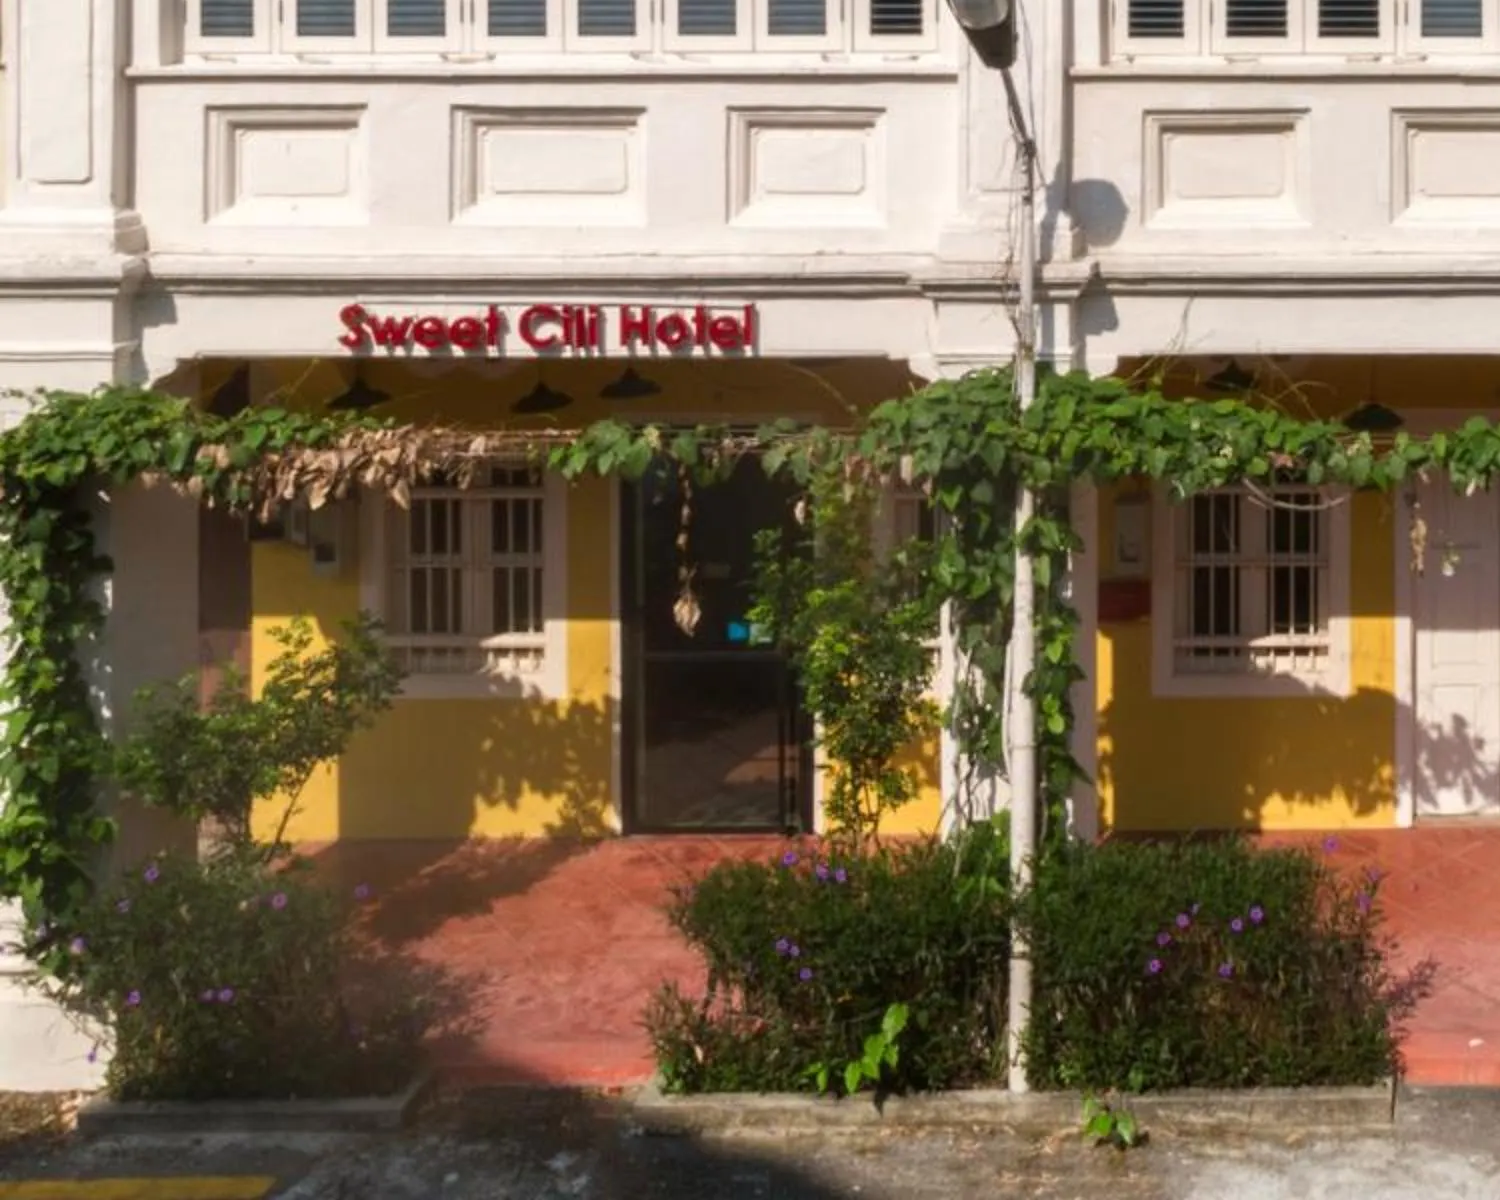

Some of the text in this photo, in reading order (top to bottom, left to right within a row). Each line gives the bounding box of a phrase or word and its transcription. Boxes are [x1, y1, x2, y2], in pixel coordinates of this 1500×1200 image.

[339, 303, 756, 349] Sweet Cili Hotel
